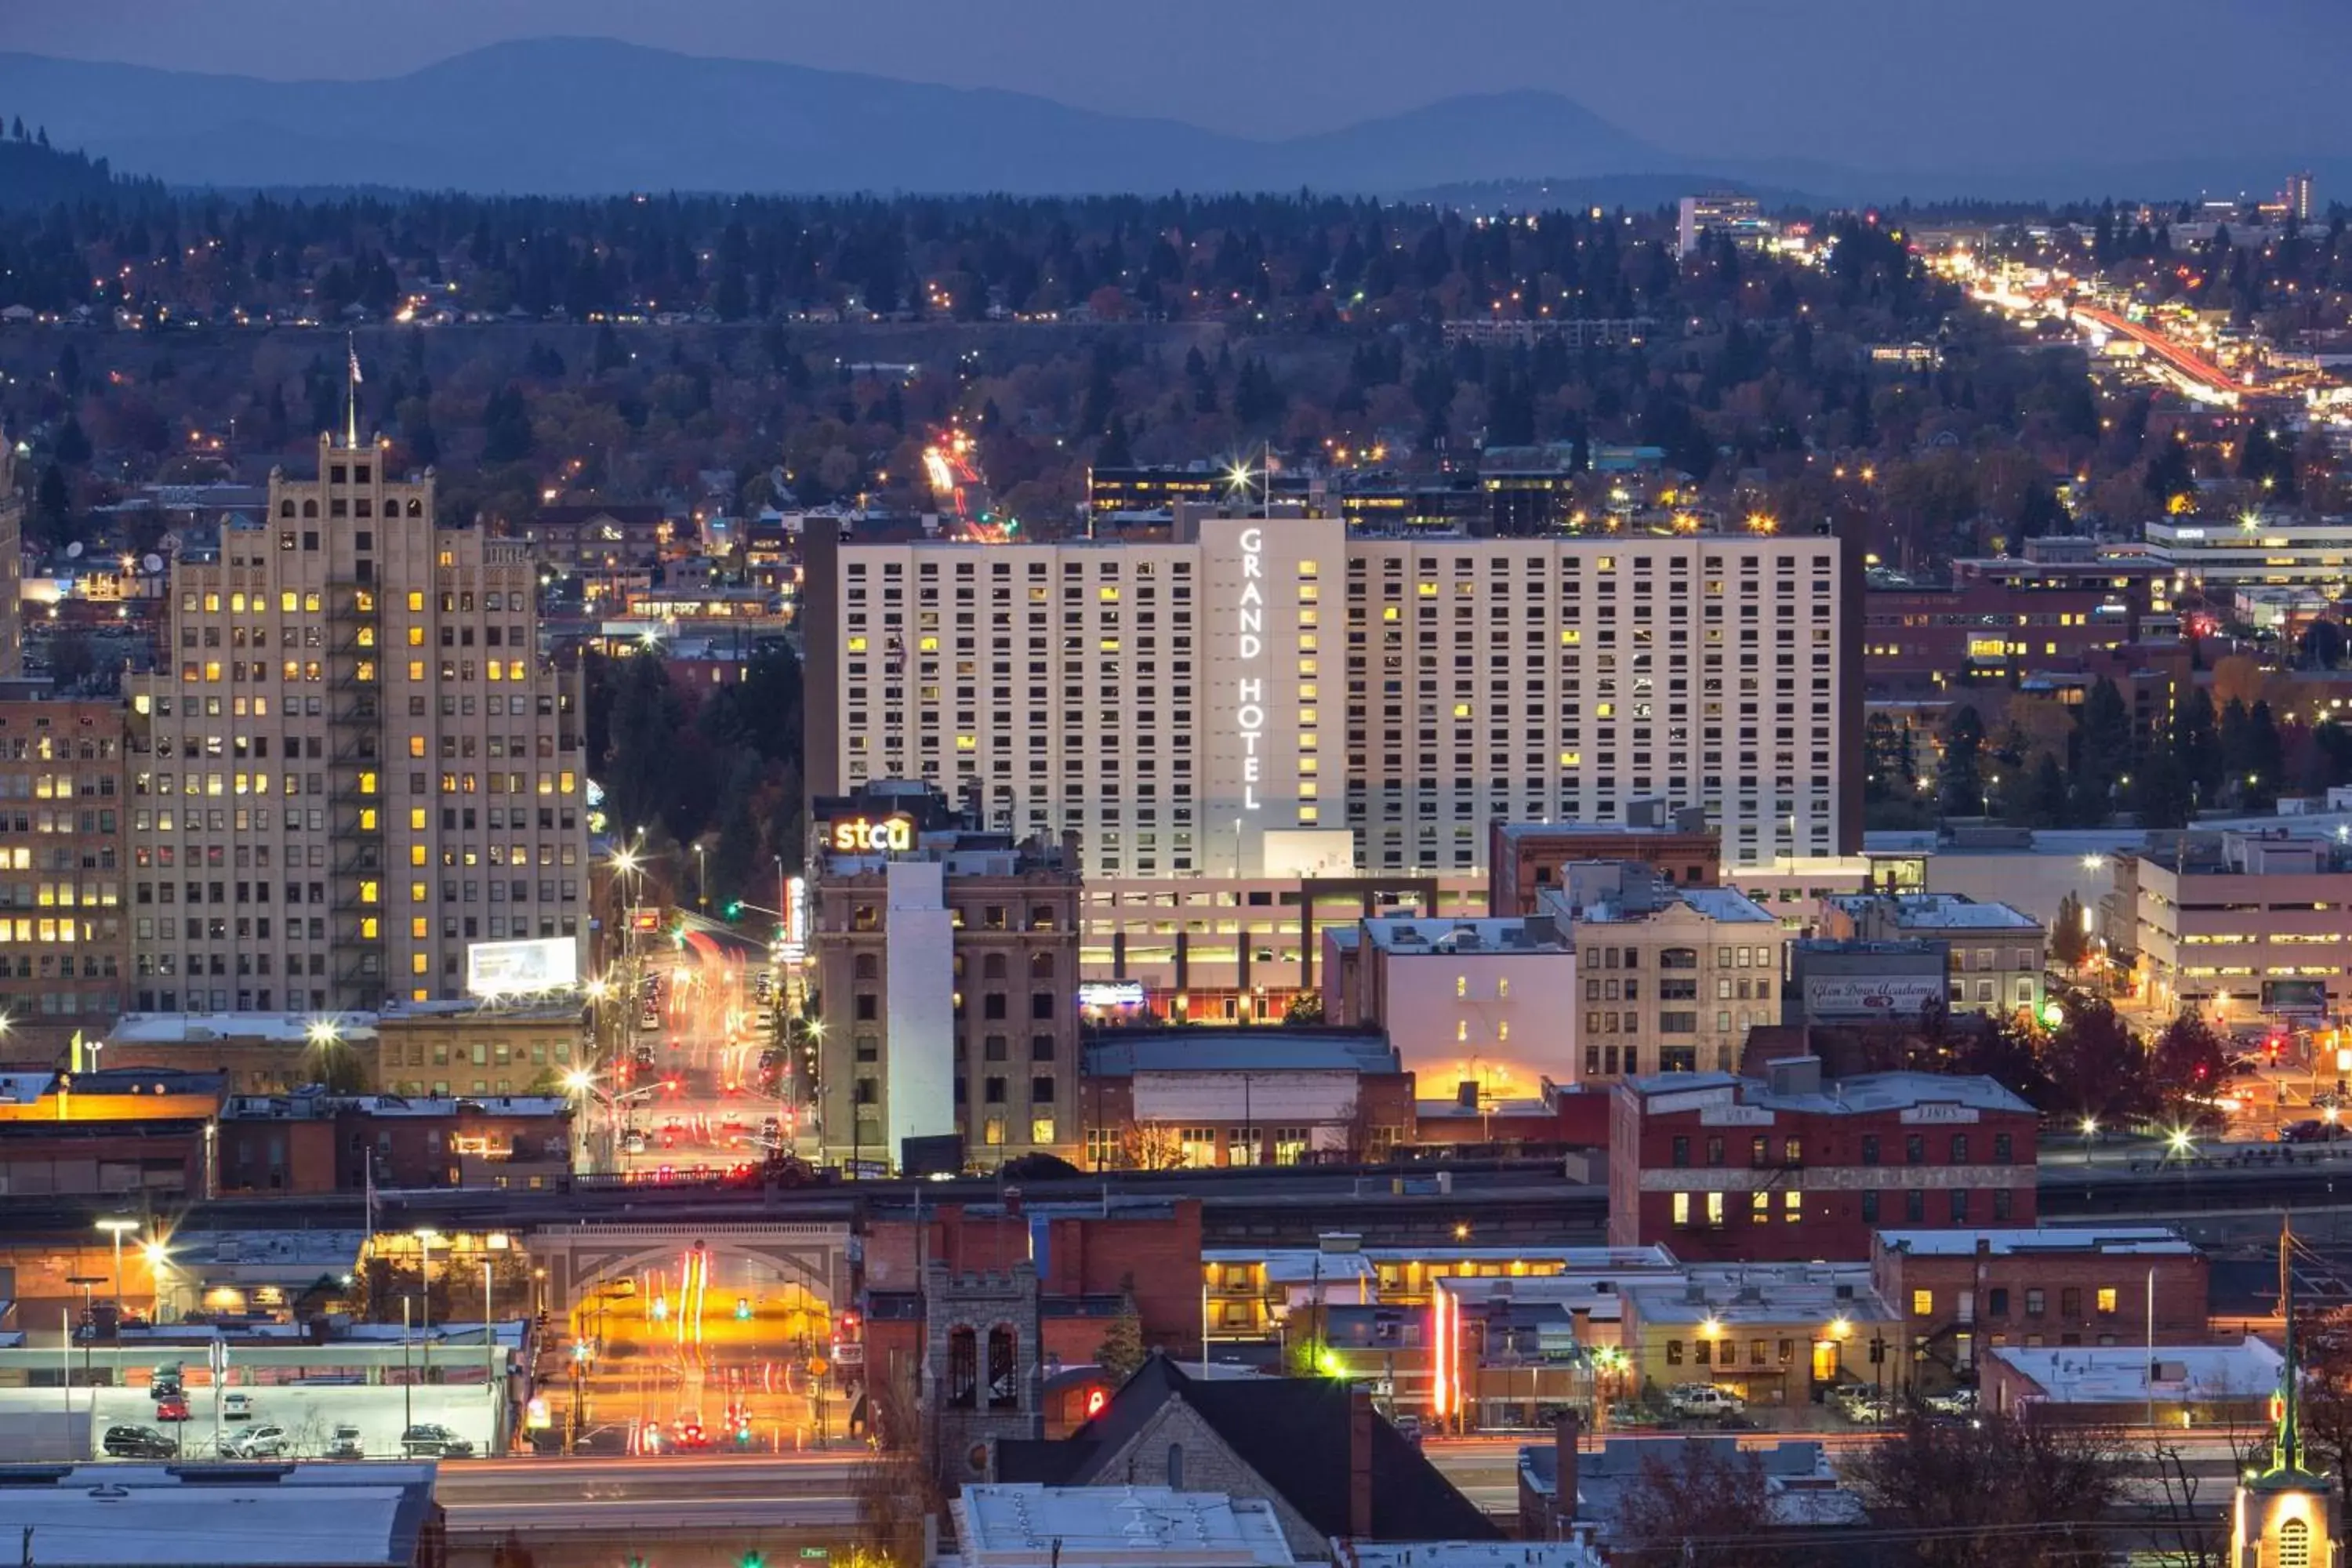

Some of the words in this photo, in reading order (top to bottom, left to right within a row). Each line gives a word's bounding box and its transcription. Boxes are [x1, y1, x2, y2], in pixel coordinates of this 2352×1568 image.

[1240, 528, 1263, 659] GRAND
[1237, 677, 1264, 810] HOTEL
[836, 817, 911, 851] stcu
[1878, 981, 1938, 996] Academy
